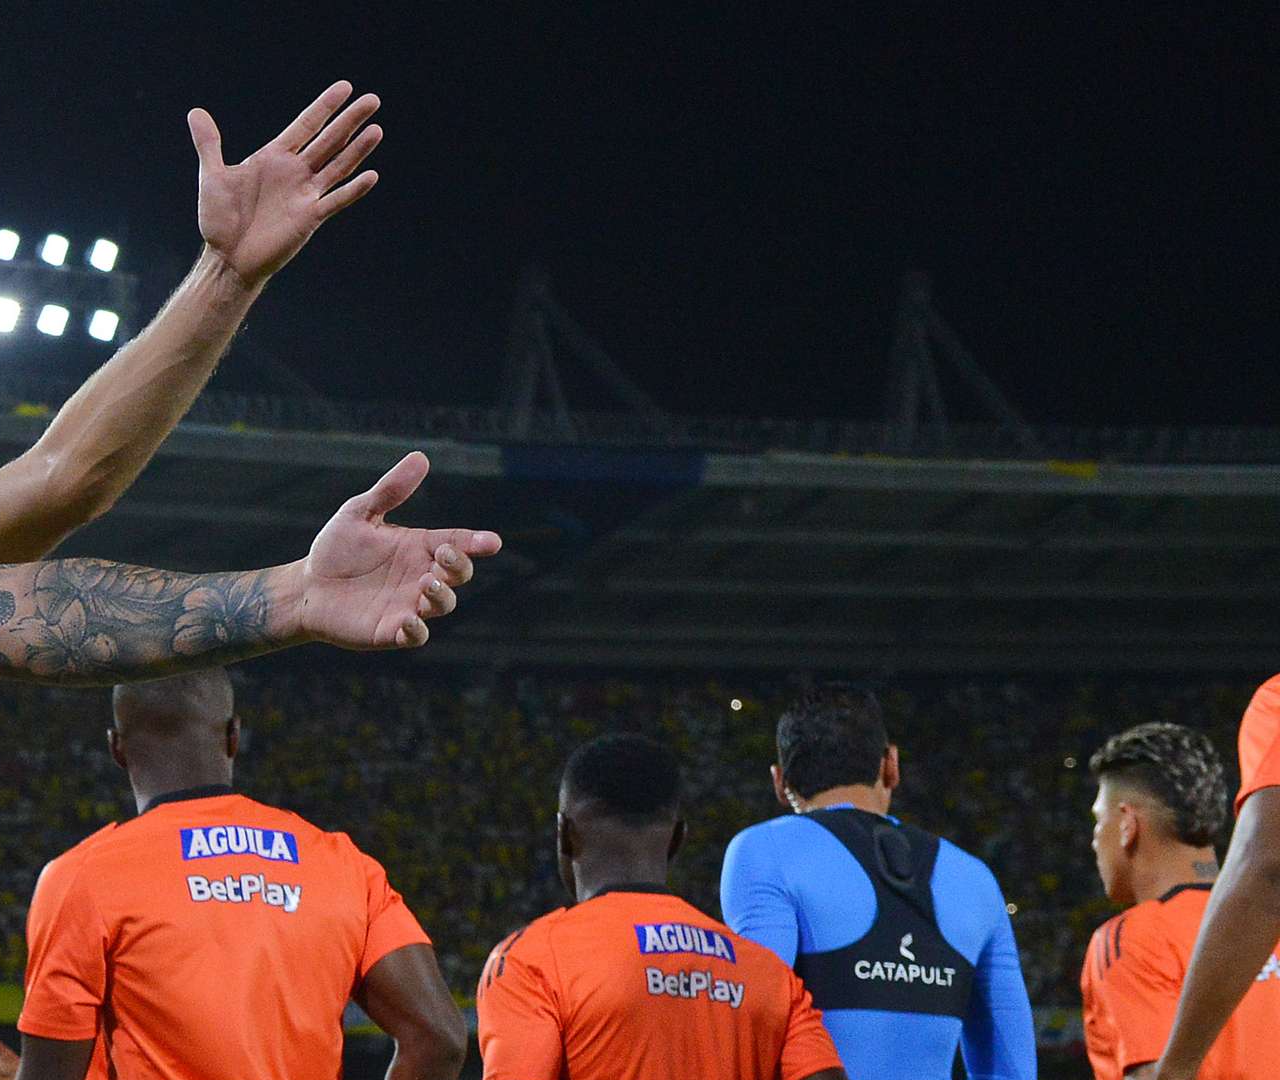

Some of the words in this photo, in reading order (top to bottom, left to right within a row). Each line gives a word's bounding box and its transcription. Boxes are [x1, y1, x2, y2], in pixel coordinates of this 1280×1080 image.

[187, 825, 294, 861] AGUILA
[187, 874, 301, 912] BetPlay
[645, 924, 732, 961] AGUILA
[646, 967, 744, 1009] BetPlay
[854, 960, 956, 987] CATAPULT
